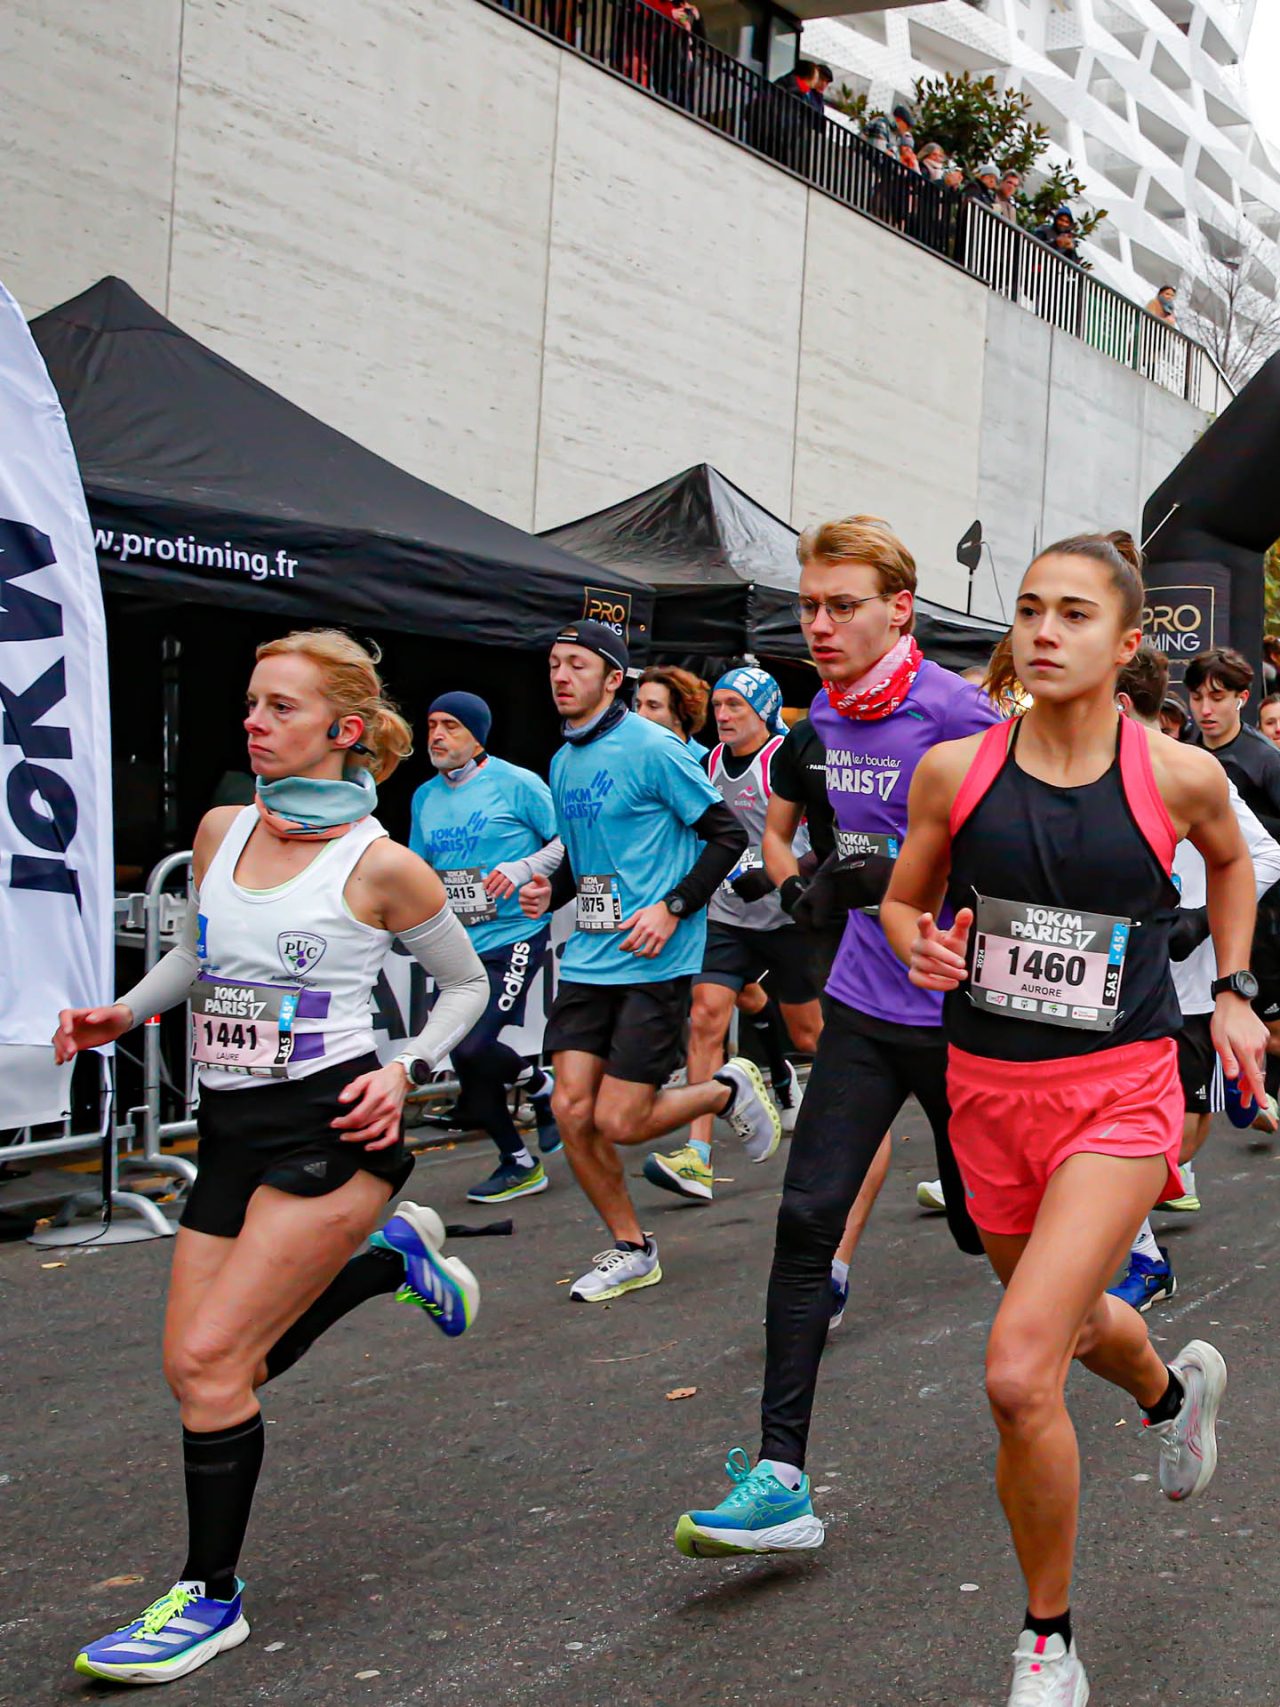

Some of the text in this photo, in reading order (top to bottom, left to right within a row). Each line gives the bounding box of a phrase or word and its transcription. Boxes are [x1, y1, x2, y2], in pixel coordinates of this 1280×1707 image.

[588, 599, 626, 623] PRO
[1141, 604, 1202, 633] PRO
[826, 748, 902, 769] 0KM les boucles
[446, 886, 476, 899] 3415
[1026, 907, 1083, 930] 10KM
[284, 940, 318, 960] PUC
[976, 948, 986, 969] 2024
[498, 941, 531, 1012] adidas
[1008, 945, 1086, 987] 1460
[214, 986, 256, 1002] 10KM
[1020, 983, 1063, 998] AURORE
[1104, 972, 1119, 998] SAS
[203, 1020, 257, 1050] 1441
[216, 1052, 240, 1061] LAURE
[278, 1037, 291, 1058] SAS
